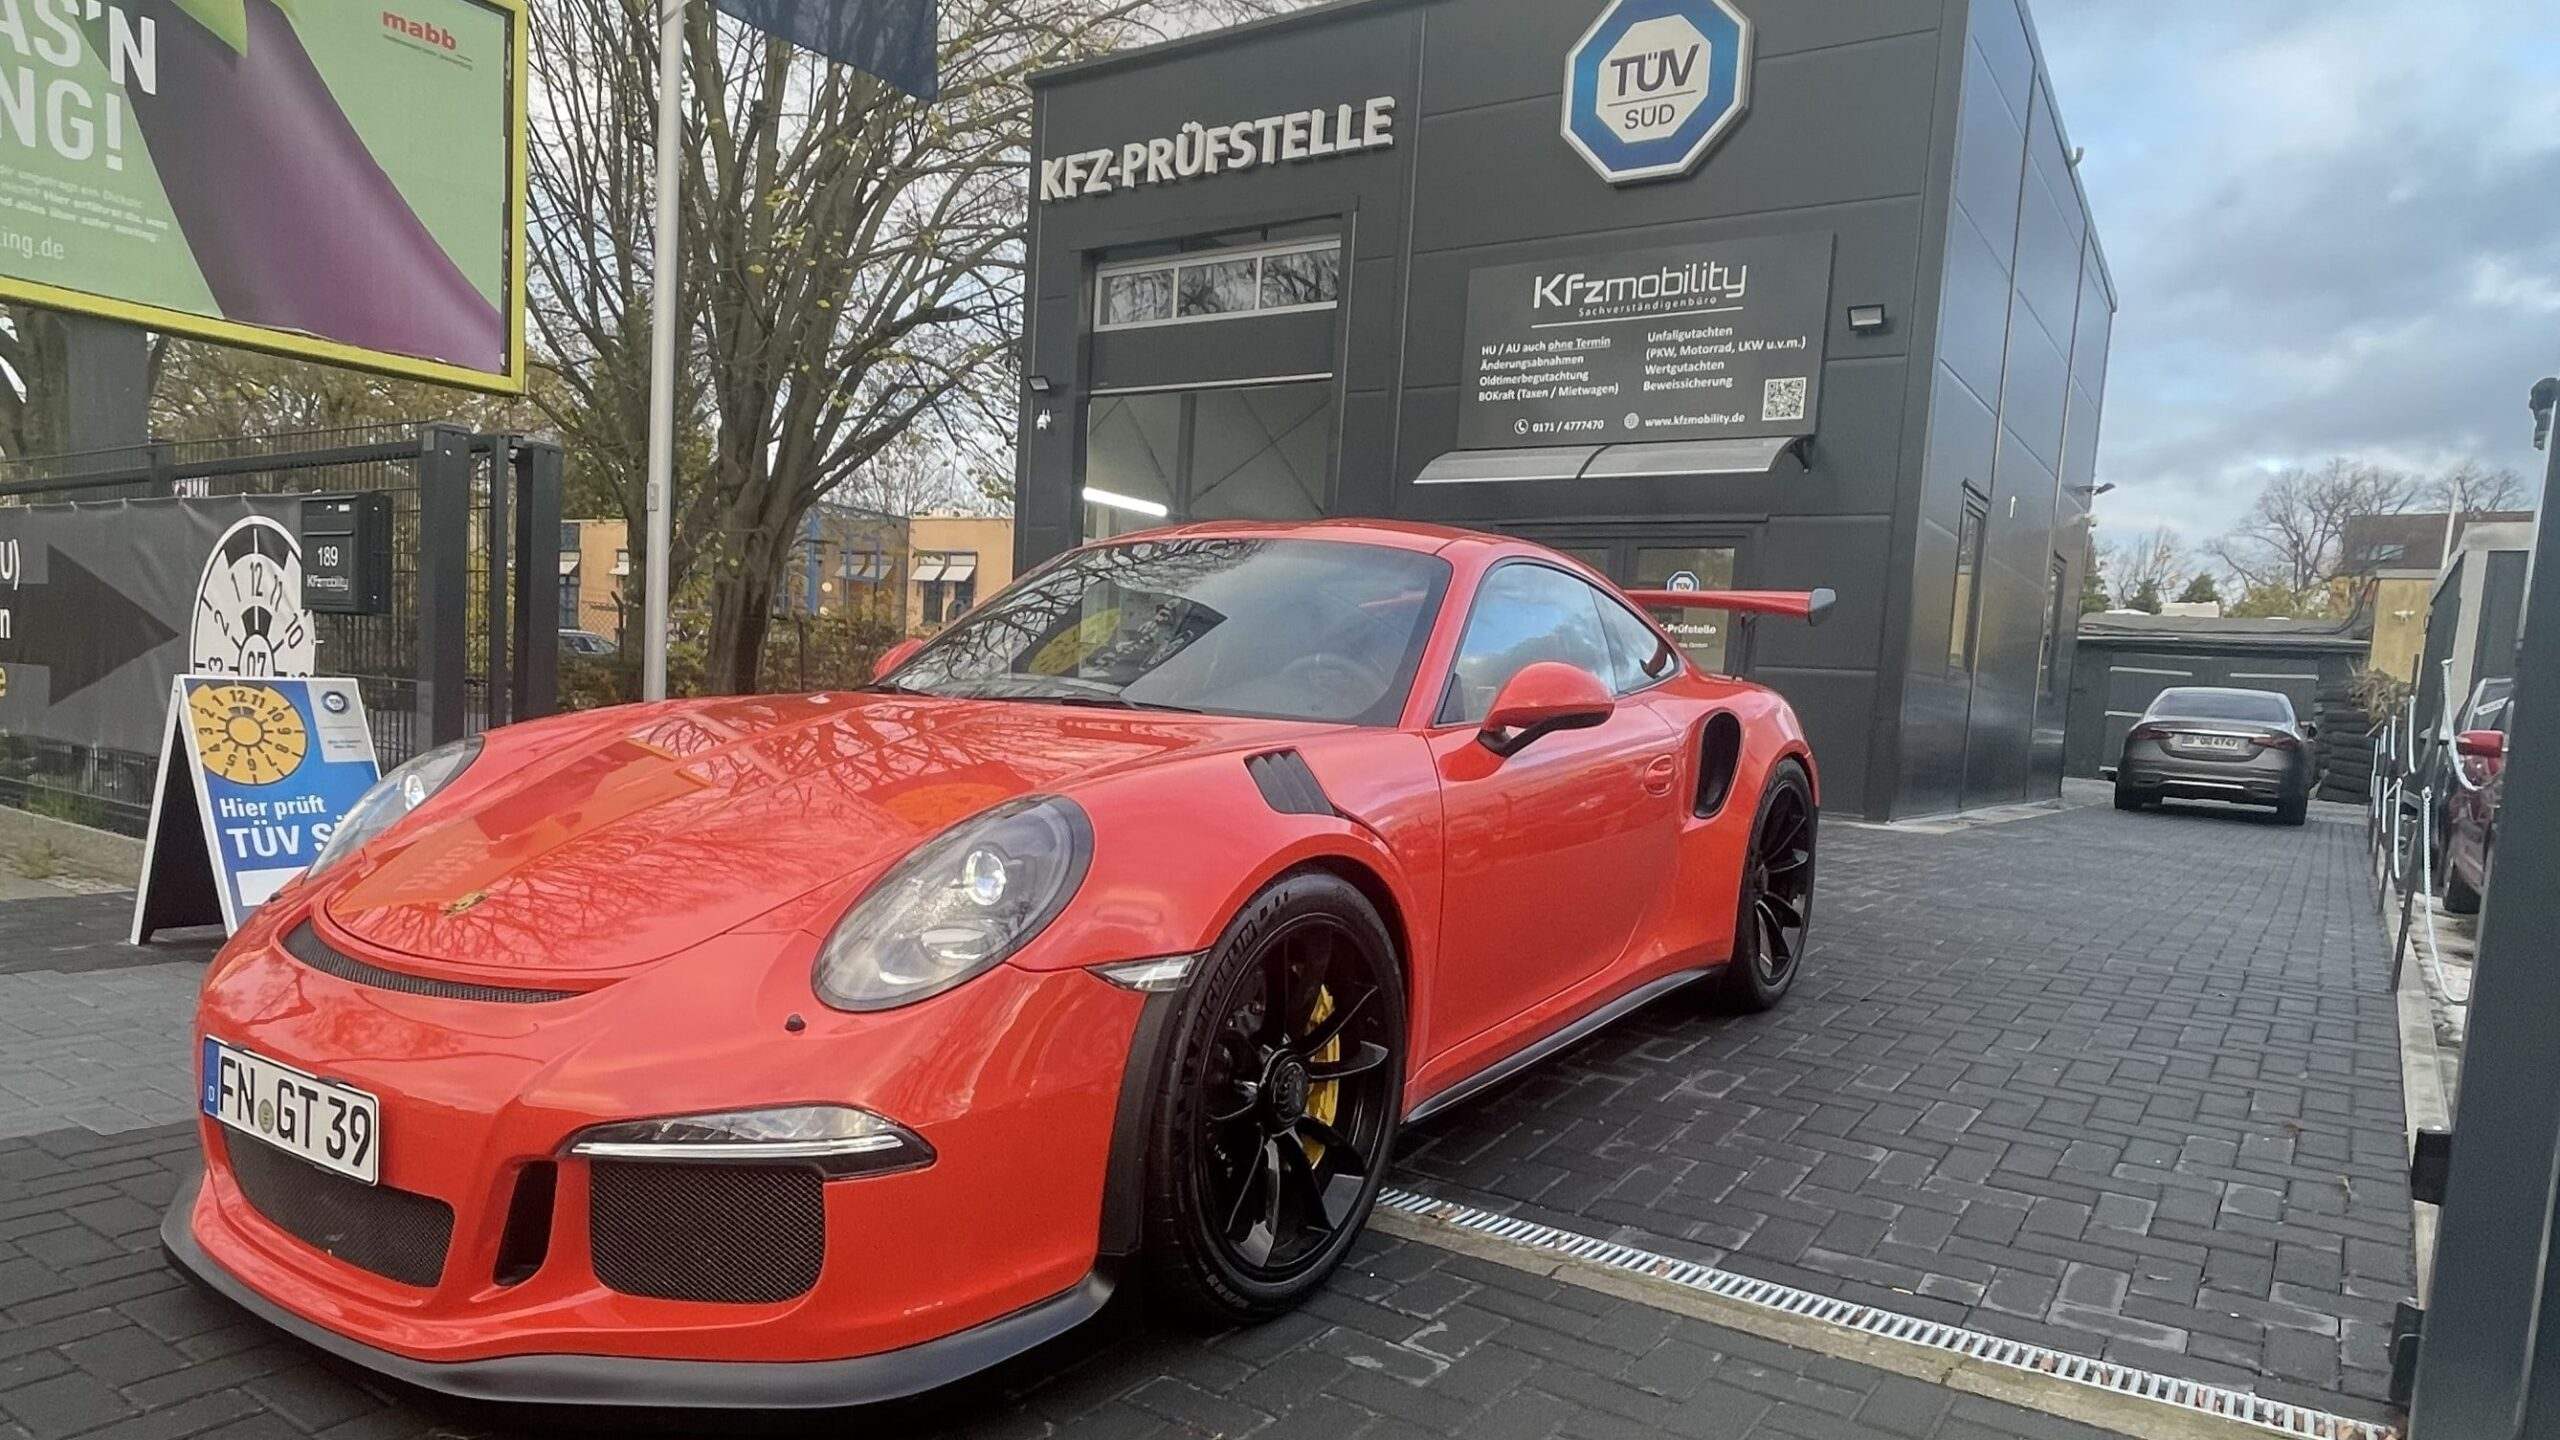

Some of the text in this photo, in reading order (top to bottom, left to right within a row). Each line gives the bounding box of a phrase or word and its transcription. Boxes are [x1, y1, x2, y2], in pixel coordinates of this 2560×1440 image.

[382, 11, 457, 51] mabb
[1610, 43, 1700, 97] TÜV
[1624, 103, 1675, 130] SÜD
[1039, 96, 1396, 201] KFZ-PRÜFSTELLE
[1578, 296, 1717, 317] Sachverständigenbüro
[1647, 326, 1733, 343] Unfallgutachten
[1481, 345, 1497, 356] HU
[1505, 343, 1521, 354] AU
[1522, 341, 1547, 353] auch
[1547, 339, 1574, 351] ohne
[1575, 336, 1612, 349] Termin
[1646, 336, 1807, 361] (PKW, Motorrad, LKW u.v.m.)
[1480, 355, 1585, 371] Änderungsabnahmen
[1644, 360, 1726, 376] Wertgutachten
[1480, 371, 1590, 387] Oldtimerbegutachtung
[1642, 377, 1734, 393] Beweissicherung
[1478, 382, 1620, 402] BOKraft (Taxen / Mietwagen)
[1532, 422, 1555, 433] 0171
[1563, 419, 1605, 432] 4777470
[1645, 412, 1746, 427] www.kfzmobility.de
[317, 546, 339, 567] 189
[231, 572, 242, 603] 1
[249, 561, 264, 598] 12
[269, 573, 284, 613] 11
[213, 609, 230, 637] 2
[284, 612, 305, 650] 10
[207, 656, 224, 673] 3
[212, 695, 224, 707] 1
[229, 690, 248, 703] 12
[251, 693, 266, 709] 11
[199, 707, 217, 719] 2
[266, 706, 286, 723] 10
[198, 726, 214, 736] 3
[274, 742, 290, 754] 8
[225, 753, 238, 767] 5
[263, 752, 278, 767] 7
[218, 795, 328, 822] Hier prüft
[226, 814, 346, 859] TÜV S
[219, 1055, 372, 1168] FN GT 39
